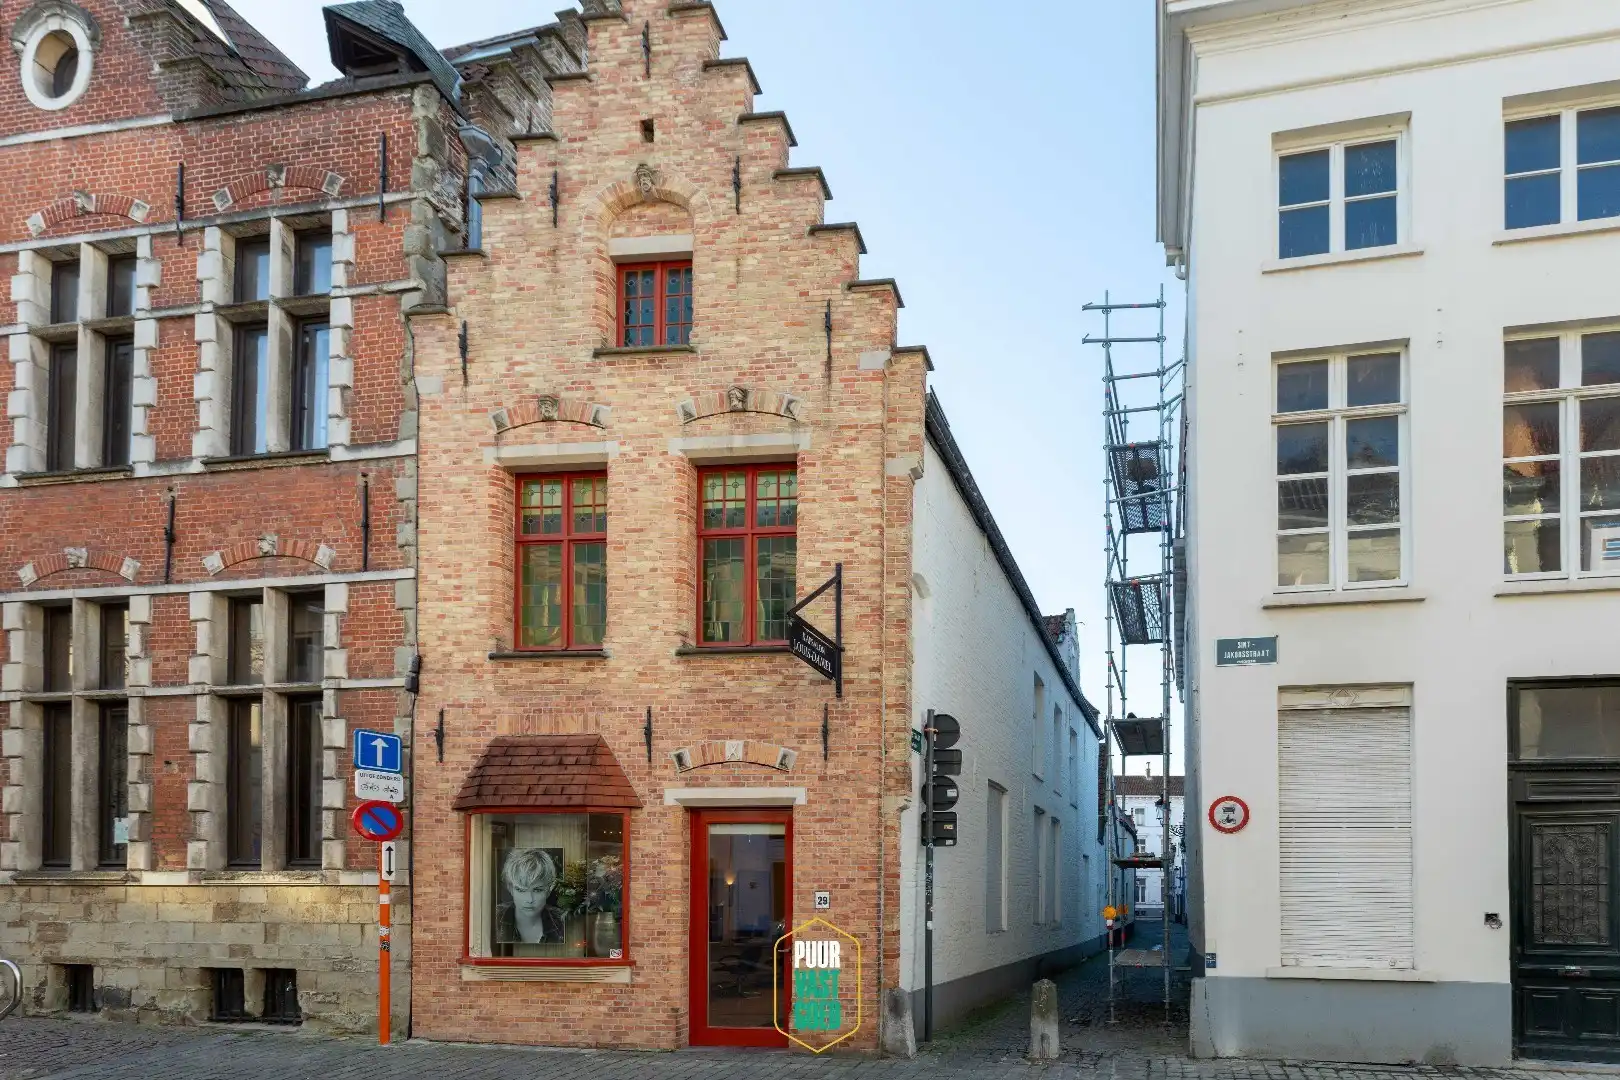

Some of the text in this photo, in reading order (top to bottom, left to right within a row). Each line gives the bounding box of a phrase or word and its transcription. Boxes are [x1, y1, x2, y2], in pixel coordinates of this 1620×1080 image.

[1223, 649, 1270, 659] JAKOBSSTRAAT
[359, 772, 401, 781] UITGEZONDERD
[818, 896, 828, 905] 29
